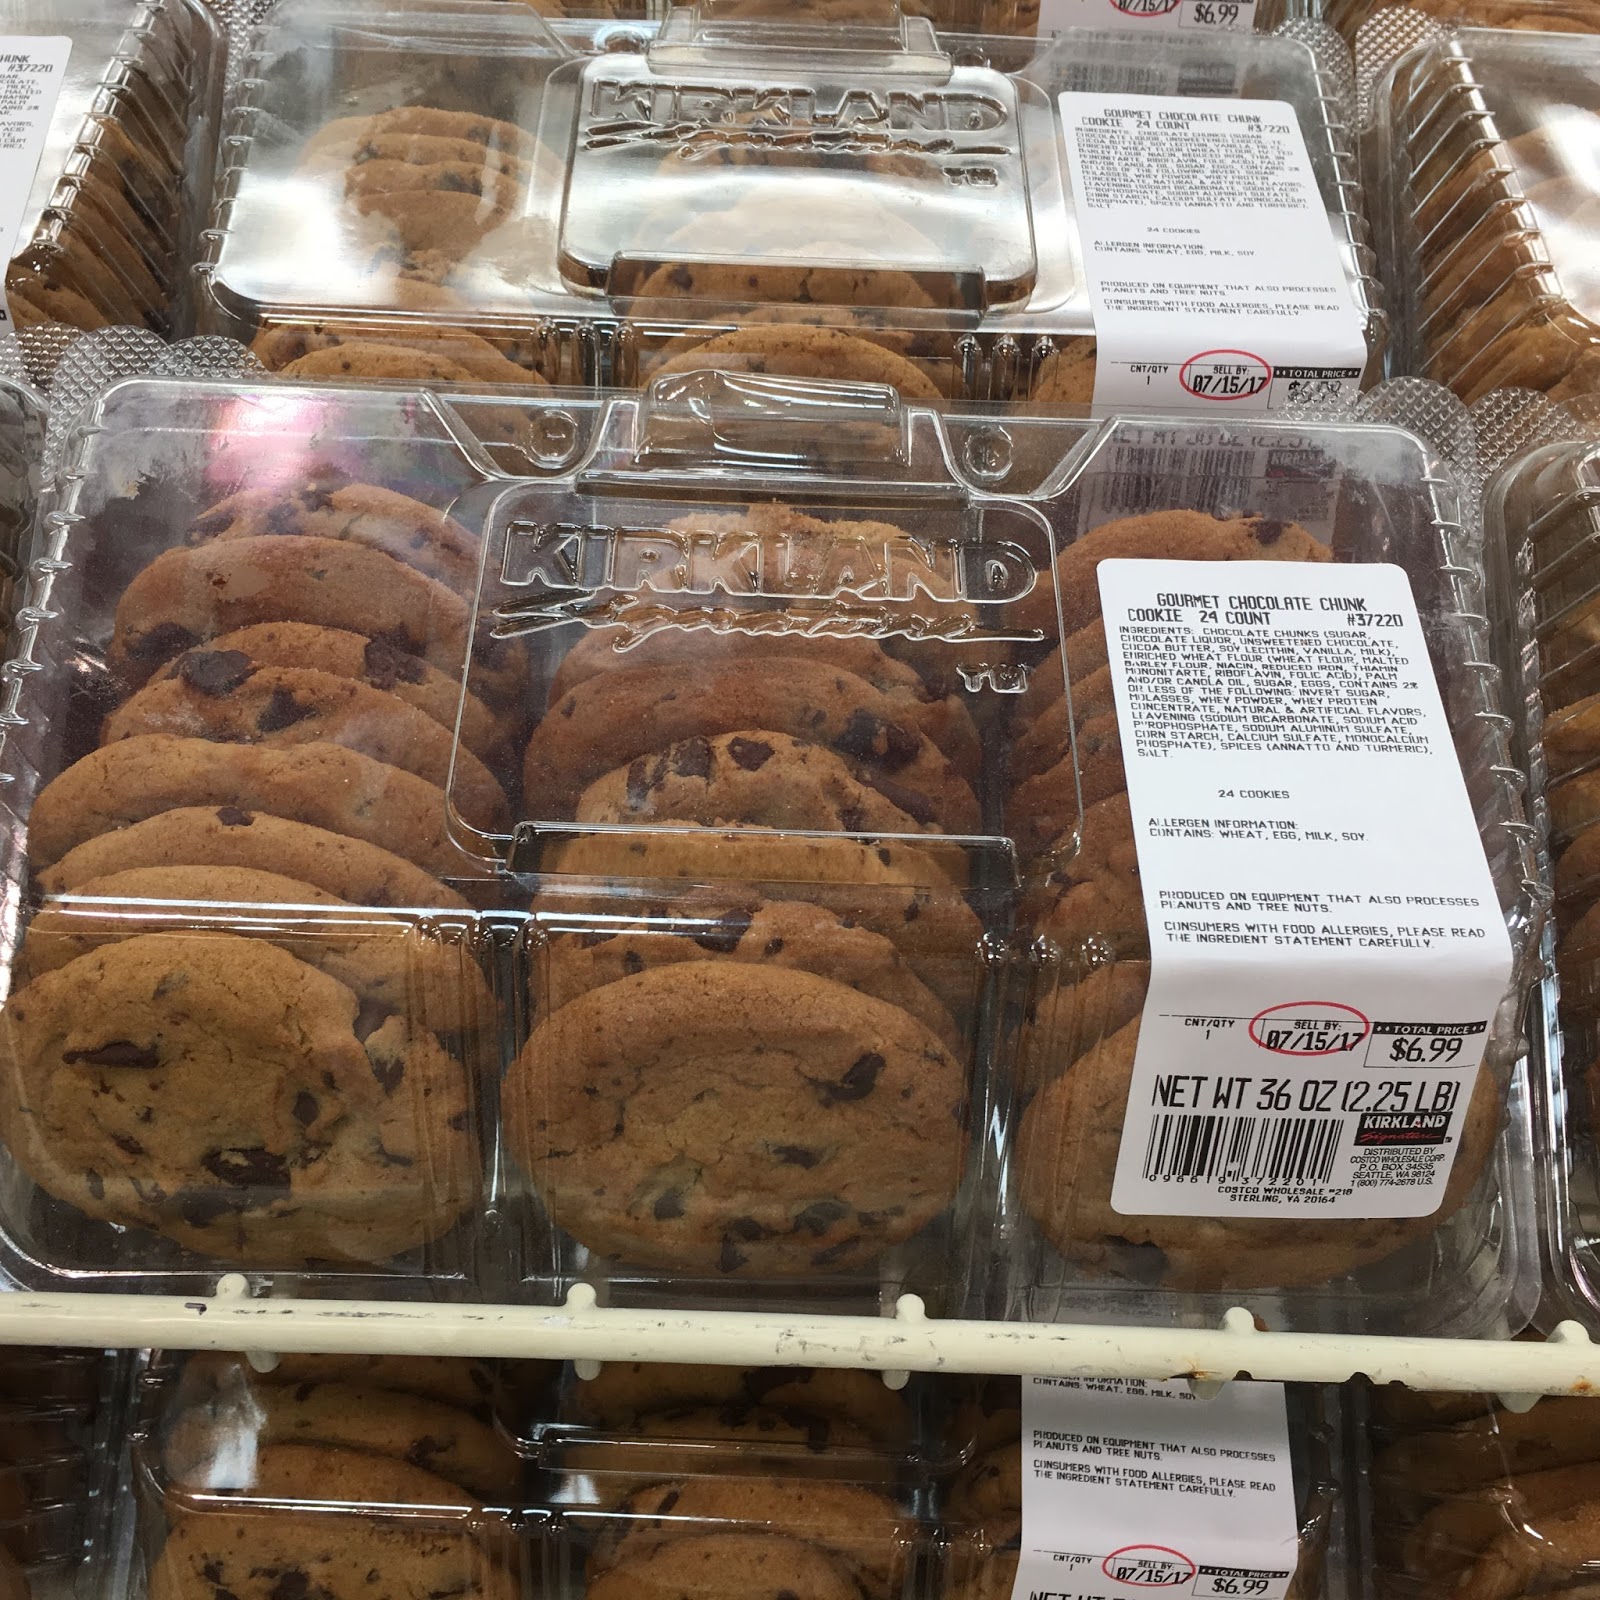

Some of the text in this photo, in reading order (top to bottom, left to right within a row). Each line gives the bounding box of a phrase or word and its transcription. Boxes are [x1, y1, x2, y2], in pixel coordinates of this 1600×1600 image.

[1194, 3, 1239, 24] $6.99
[588, 78, 1008, 130] KIRKLAND
[1104, 109, 1261, 123] GOURMET CHOCOLATE CHUNK
[1082, 117, 1190, 130] COOKIE 24 COUNT
[1131, 365, 1168, 373] CNT/QTY
[1213, 366, 1233, 375] SELL
[1289, 369, 1346, 378] TOTAL PRICE
[1193, 375, 1267, 394] 07/15/17
[500, 521, 1038, 603] KIRKLAND
[1157, 593, 1367, 611] GOURMET CHOCOLATE CHUNK
[1128, 608, 1270, 625] COOKIE 24 COUNT
[1347, 613, 1404, 627] #37220
[1203, 628, 1269, 637] CHOCOLATE
[1219, 644, 1240, 652] SOY
[1239, 638, 1322, 646] UNSWEETENED
[1181, 653, 1222, 661] WHEAT
[1227, 653, 1263, 662] FLOUR
[1267, 655, 1312, 663] (WHEAT
[1362, 656, 1409, 665] MALTED
[1176, 677, 1224, 686] CANOLA
[1339, 680, 1398, 689] CONTAINS
[1147, 685, 1177, 694] LESS
[1181, 686, 1194, 694] OF
[1200, 687, 1222, 695] THE
[1299, 688, 1340, 696] INVERT
[1291, 697, 1323, 705] WHEY
[1328, 698, 1378, 706] PROTEIN
[1224, 705, 1280, 714] NATURAL
[1300, 706, 1362, 715] ARTIFICIAL
[1200, 713, 1248, 722] (SODIUM
[1343, 716, 1386, 724] SODIUM
[1242, 724, 1286, 732] SODIUM
[1290, 724, 1350, 733] ALUMINUM
[1227, 732, 1279, 742] CALCIUM
[1345, 734, 1429, 744] MONOCALCIUM
[1220, 740, 1262, 751] SPICES
[1266, 743, 1330, 751] (ANNATTO
[1218, 789, 1290, 799] 24 COOKIES
[1214, 820, 1298, 830] INFORMATION:
[1219, 830, 1338, 842] WHEAT, EGG, MILK,
[1229, 892, 1479, 906] ON EQUIPMENT THAT ALSO PROCESSES
[1226, 902, 1252, 911] AND
[1257, 902, 1289, 912] TREE
[1245, 923, 1485, 938] WITH FOOD ALLERGIES, PLEASE READ
[1196, 934, 1352, 946] INGREDIENT STATEMENT
[1185, 1018, 1235, 1027] CNT/QTY
[1294, 1020, 1341, 1030] SELL BY:
[1206, 1029, 1210, 1040] 1
[1394, 1025, 1470, 1034] TOTAL PRICE
[1267, 1030, 1364, 1051] 07/15/17
[1390, 1036, 1463, 1062] $6.99
[1152, 1075, 1460, 1113] NET WT 36 OZ (2.25 LB)
[1364, 1114, 1446, 1128] KIRKLAND
[1360, 1131, 1441, 1144] Signature
[1364, 1147, 1421, 1155] DISTRIBUTED
[1381, 1155, 1424, 1163] WHOLESALE
[1425, 1154, 1445, 1162] CORP.
[1357, 1179, 1378, 1188] (800)
[1218, 1186, 1259, 1194] COSTCO
[1263, 1187, 1326, 1195] WHOLESALE
[1230, 1194, 1282, 1204] STERLING,
[1304, 1195, 1336, 1203] 20164
[1086, 1436, 1187, 1453] ON EQUIPMENT THAT
[1082, 1445, 1130, 1458] AND TREE
[1056, 1472, 1174, 1490] INGREDIENT STATEMENT
[1094, 1466, 1276, 1492] WITH FOOD READ
[1053, 1555, 1092, 1564] CNT/QTY
[1117, 1566, 1192, 1584] 07/15/17
[1212, 1577, 1270, 1595] $6.99
